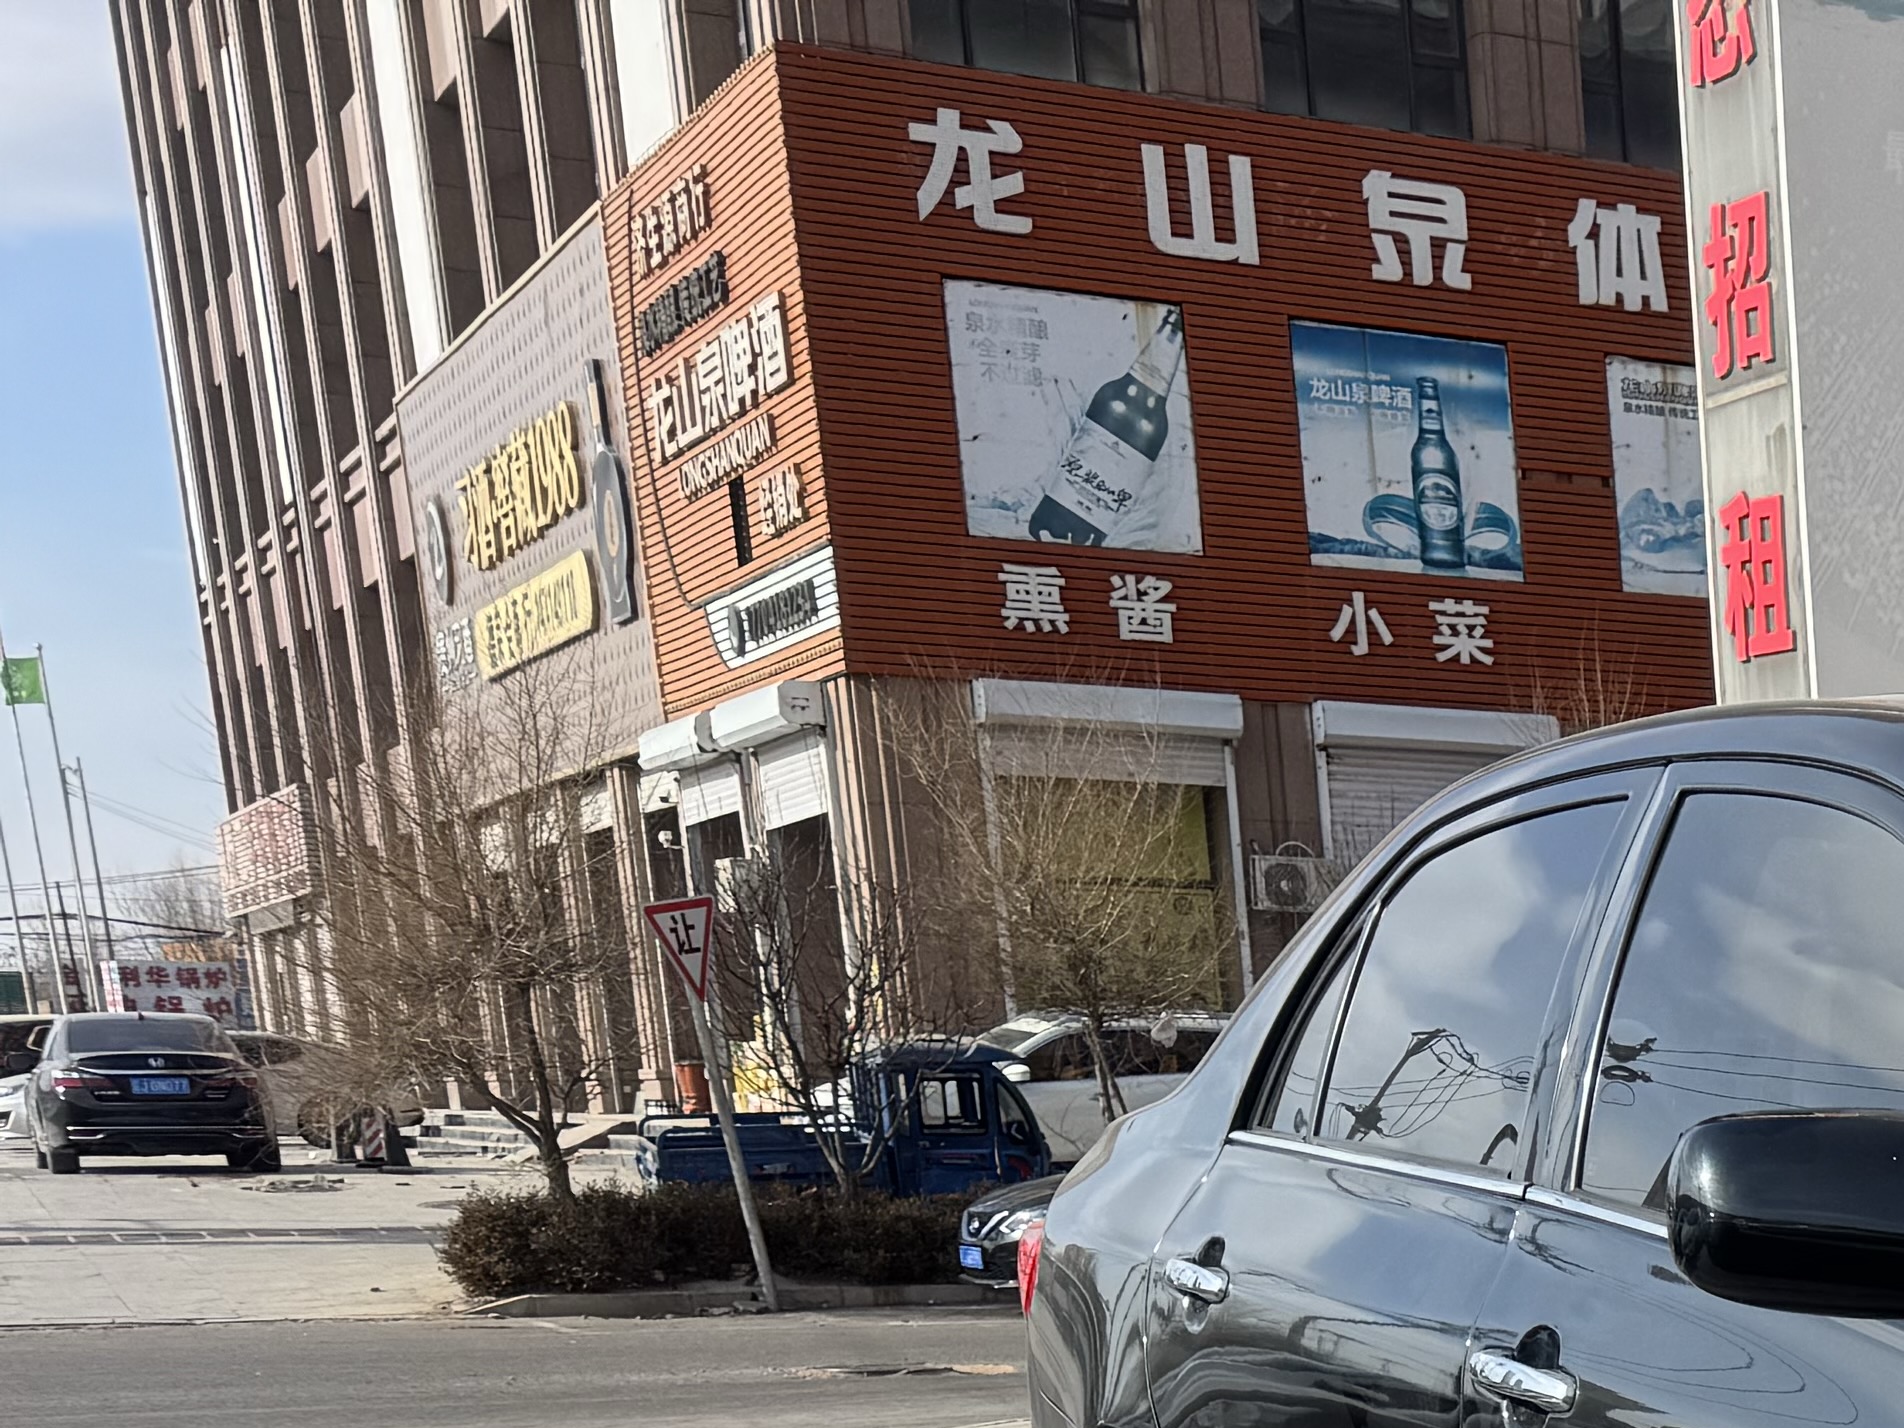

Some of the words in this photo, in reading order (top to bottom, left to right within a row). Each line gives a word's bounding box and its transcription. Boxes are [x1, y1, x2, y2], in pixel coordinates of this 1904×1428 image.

[909, 108, 1669, 314] 龙山泉体
[647, 291, 790, 465] 龙山泉啤酒
[1309, 377, 1412, 409] 龙山泉啤酒
[998, 563, 1178, 644] 熏酱
[1331, 592, 1495, 666] 小菜
[670, 913, 701, 955] 让
